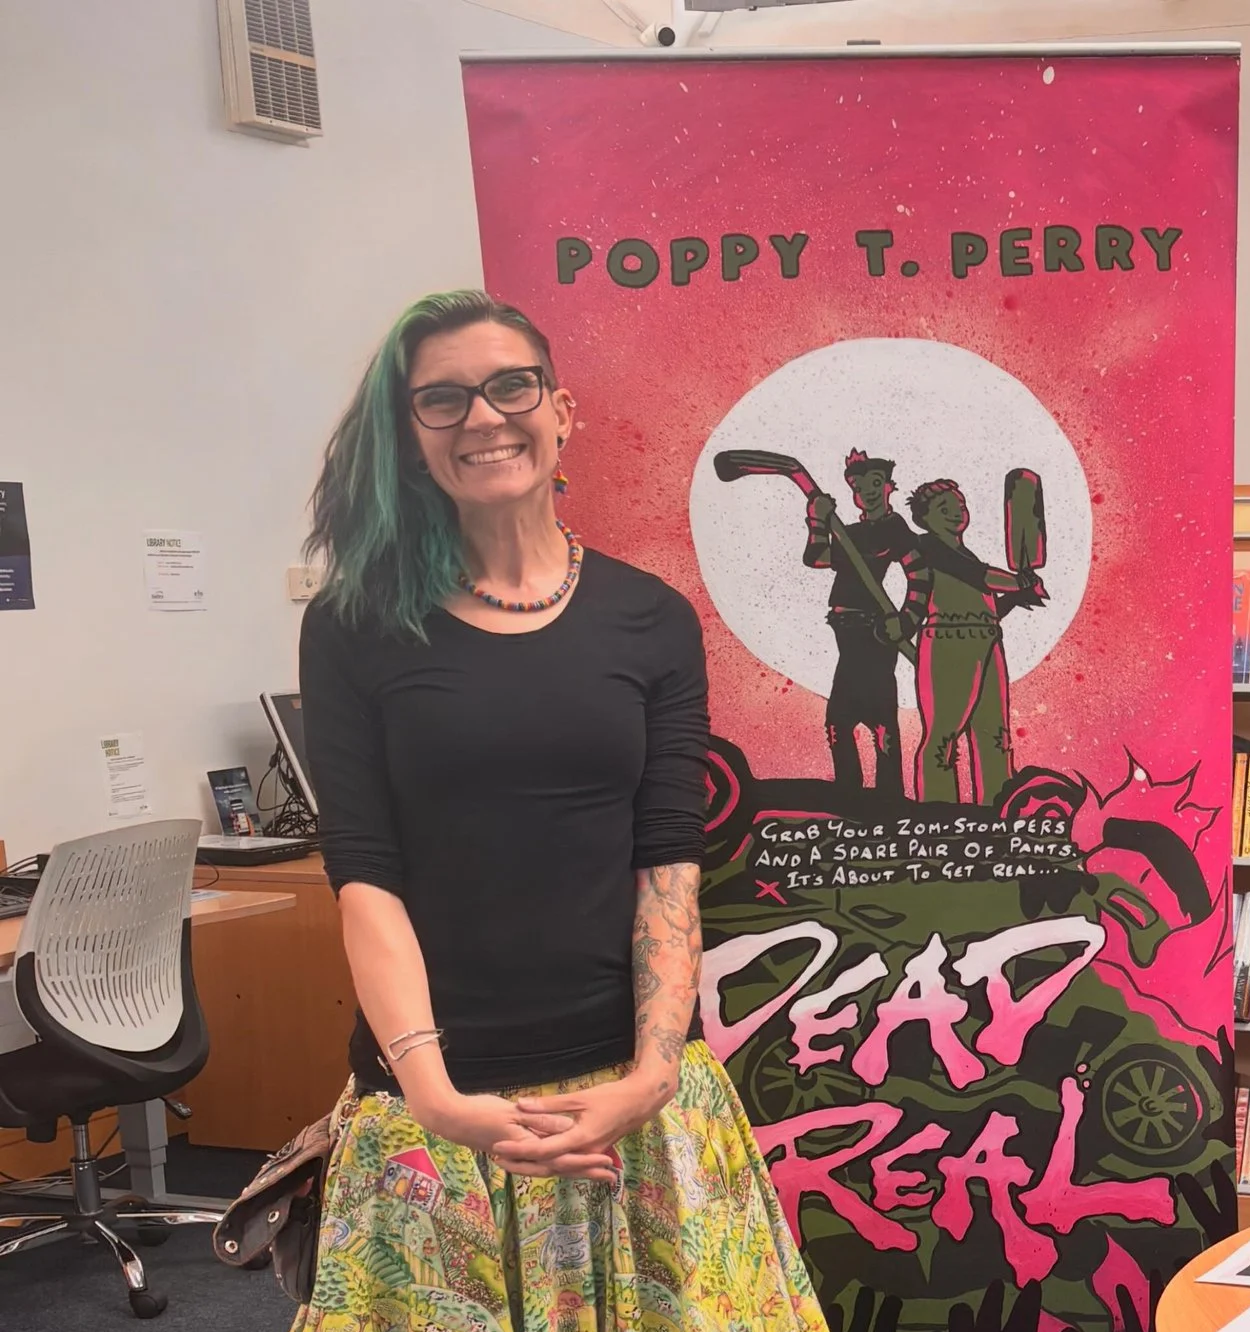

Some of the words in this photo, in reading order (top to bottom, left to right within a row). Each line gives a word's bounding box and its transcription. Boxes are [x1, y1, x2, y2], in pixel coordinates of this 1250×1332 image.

[556, 233, 809, 288] POPPY
[855, 230, 920, 277] T.
[951, 225, 1183, 279] PERRY
[147, 538, 165, 547] LIBRARY
[761, 823, 820, 843] GRAB
[827, 819, 885, 839] YOUR
[897, 819, 1066, 836] ZOM-STOMPERS
[755, 850, 800, 868] AND
[810, 846, 822, 865] A
[834, 843, 899, 860] SPARE
[909, 840, 948, 858] PAIR
[964, 840, 994, 858] OF
[1009, 838, 1077, 857] PANTS.
[787, 871, 822, 888] IT'S
[832, 866, 894, 885] ABOUT
[906, 863, 930, 883] TO
[942, 863, 974, 879] GET
